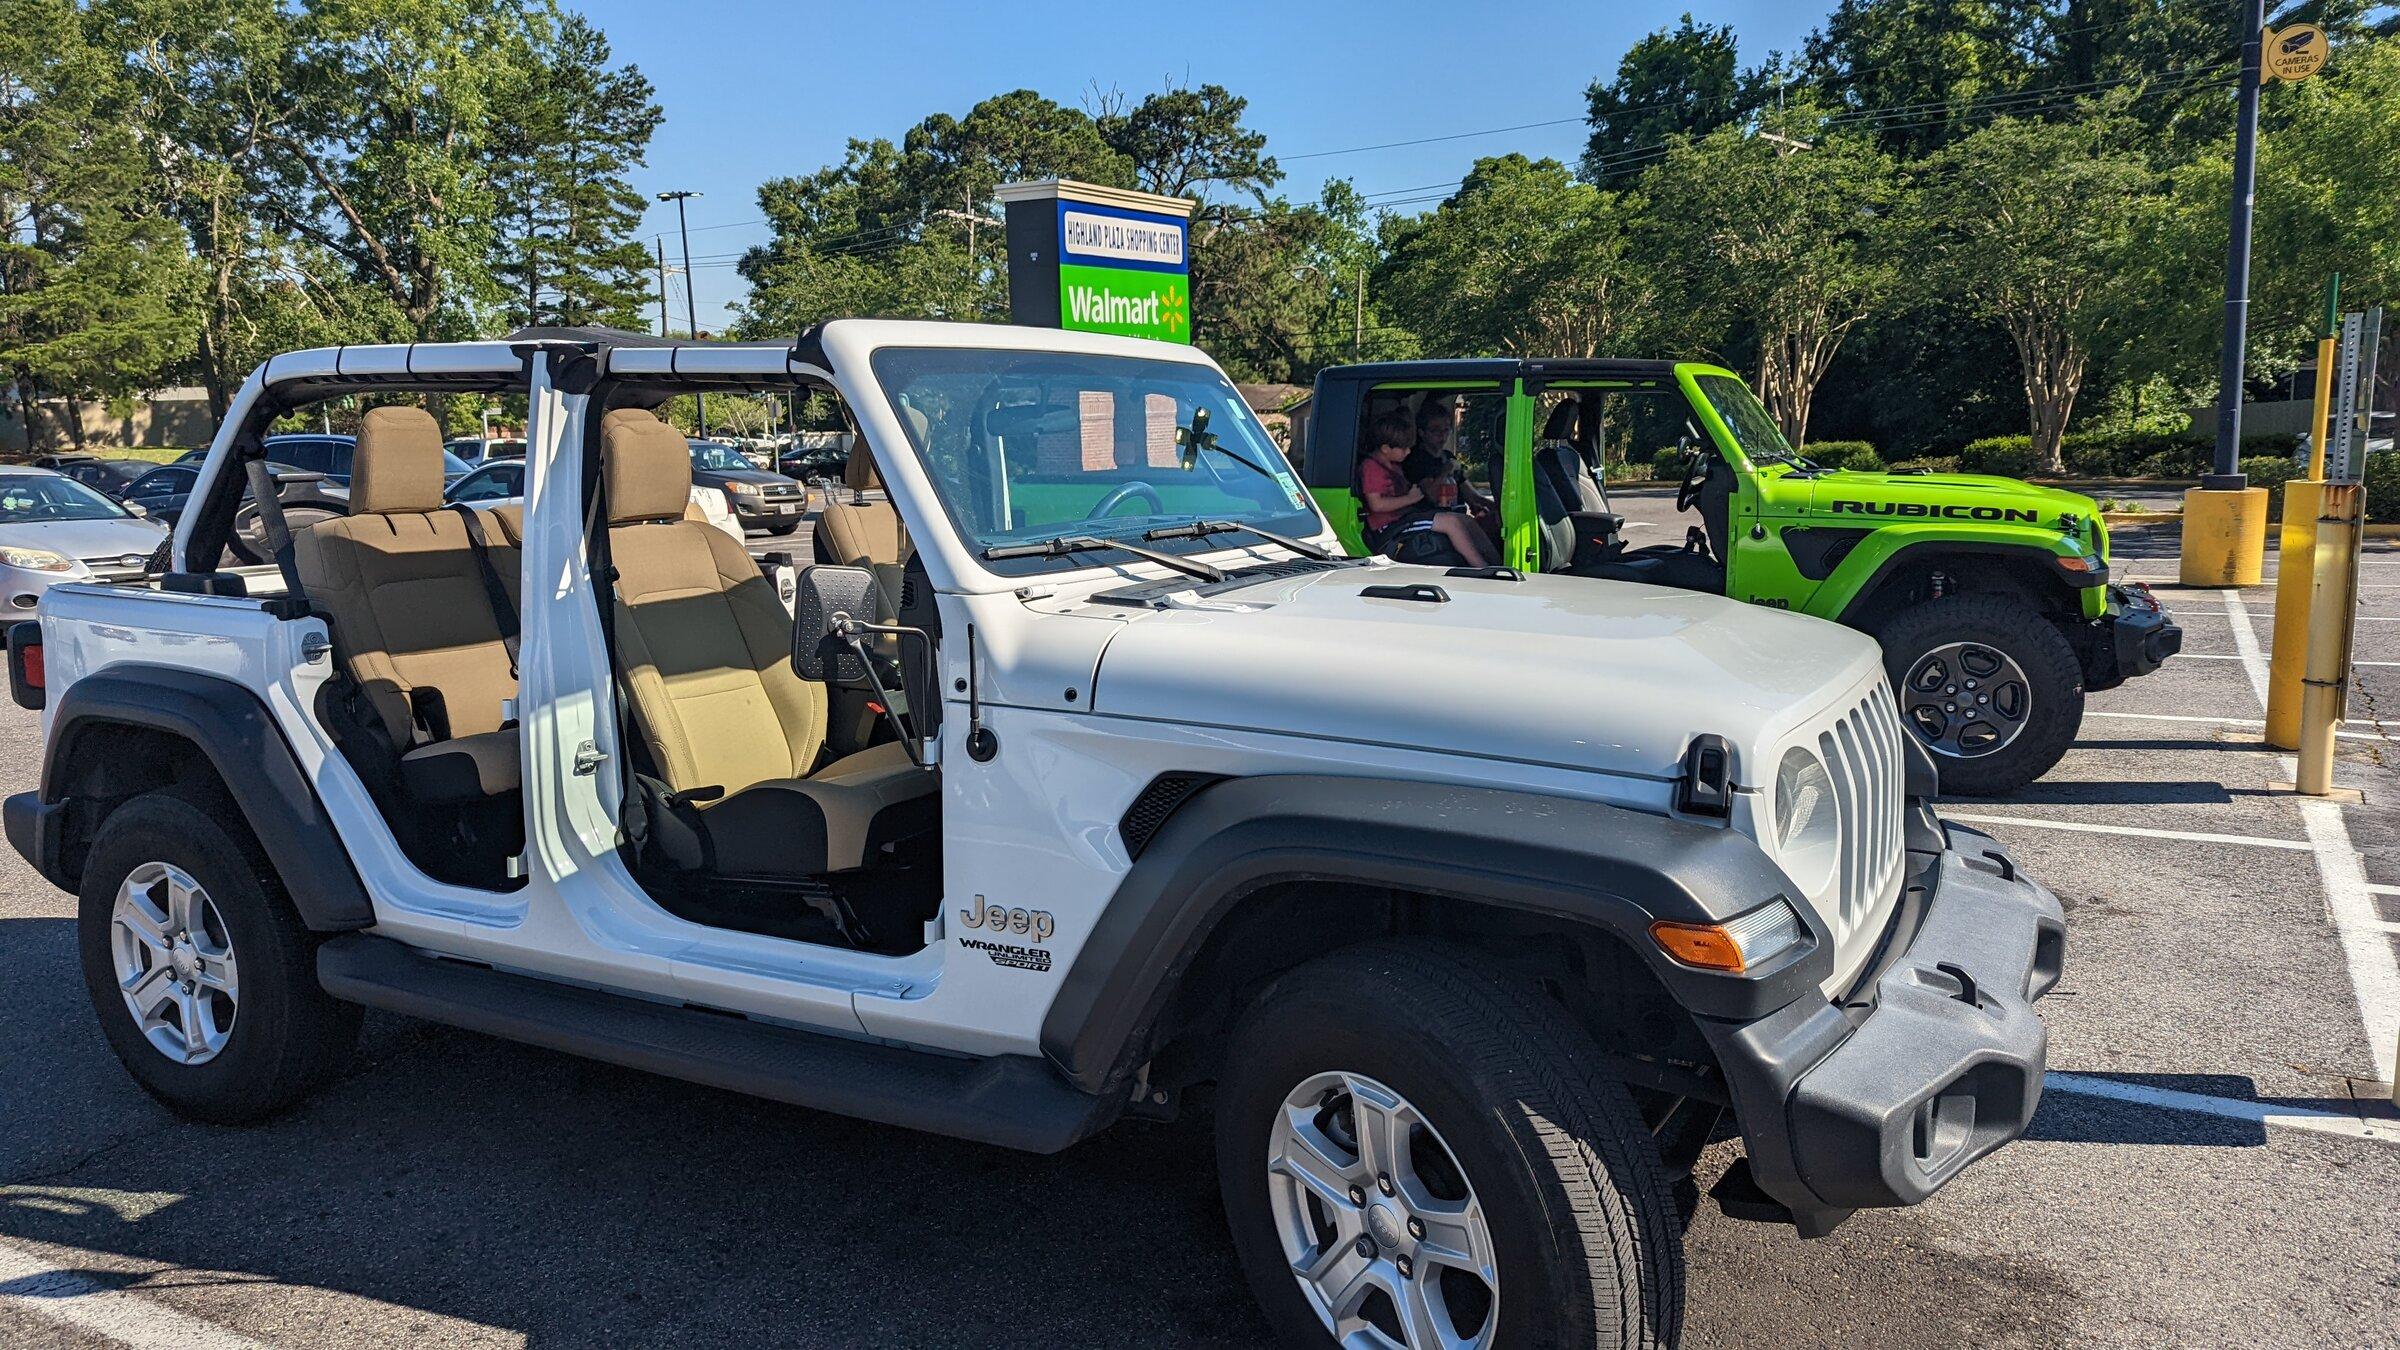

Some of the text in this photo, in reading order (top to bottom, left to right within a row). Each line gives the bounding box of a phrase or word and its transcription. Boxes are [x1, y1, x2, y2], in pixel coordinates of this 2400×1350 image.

[2275, 55, 2319, 66] CAMERAS
[2282, 65, 2310, 74] IN USE
[1068, 221, 1179, 255] HIGHLAND PLAZA SHOPPING CENTER
[1068, 285, 1159, 325] Walmart
[1832, 500, 2038, 522] RUBICON
[960, 894, 1054, 943] Jeep
[959, 938, 1051, 959] WRANGLER
[988, 951, 1051, 963] UNLIMITED
[994, 958, 1050, 971] SPORT
